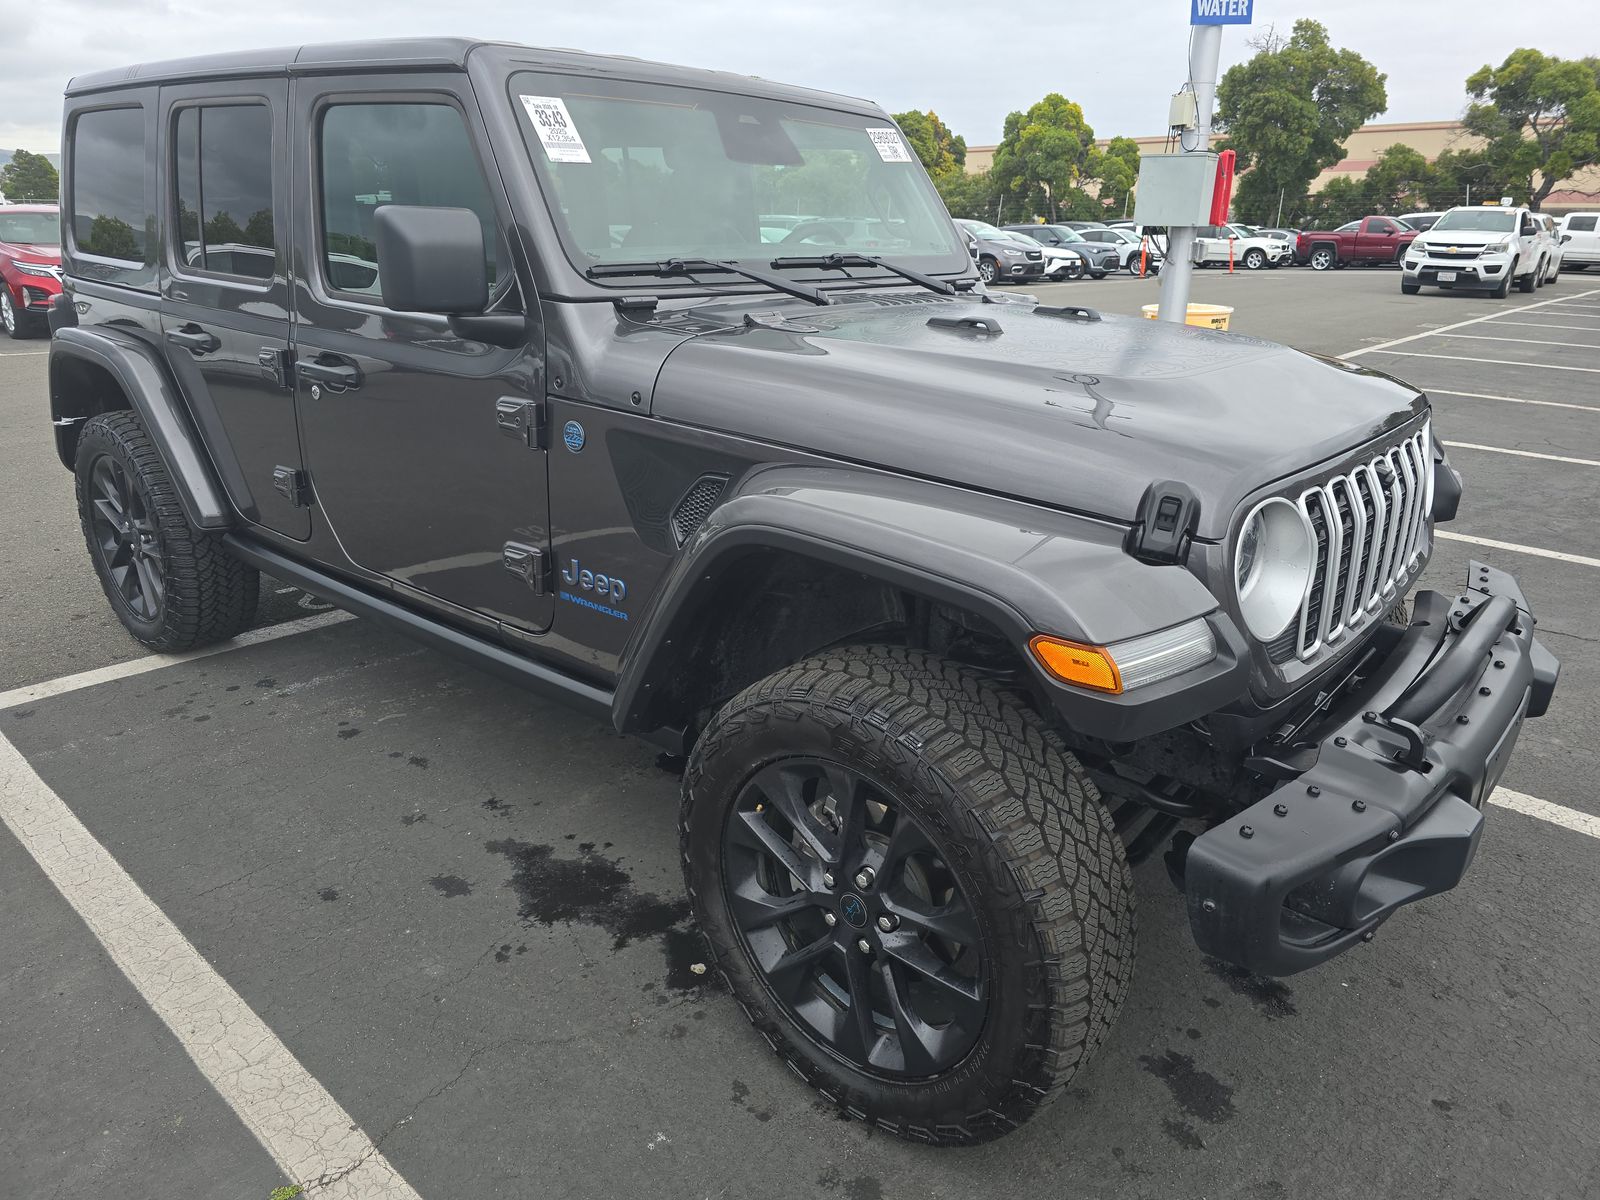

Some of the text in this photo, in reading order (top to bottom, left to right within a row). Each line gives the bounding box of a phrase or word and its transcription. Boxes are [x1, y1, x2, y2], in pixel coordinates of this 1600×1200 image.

[1196, 0, 1249, 17] WATER
[535, 109, 567, 127] 33:43
[549, 127, 567, 135] 2025
[562, 559, 626, 605] Jeep
[570, 594, 628, 621] WRANGLER
